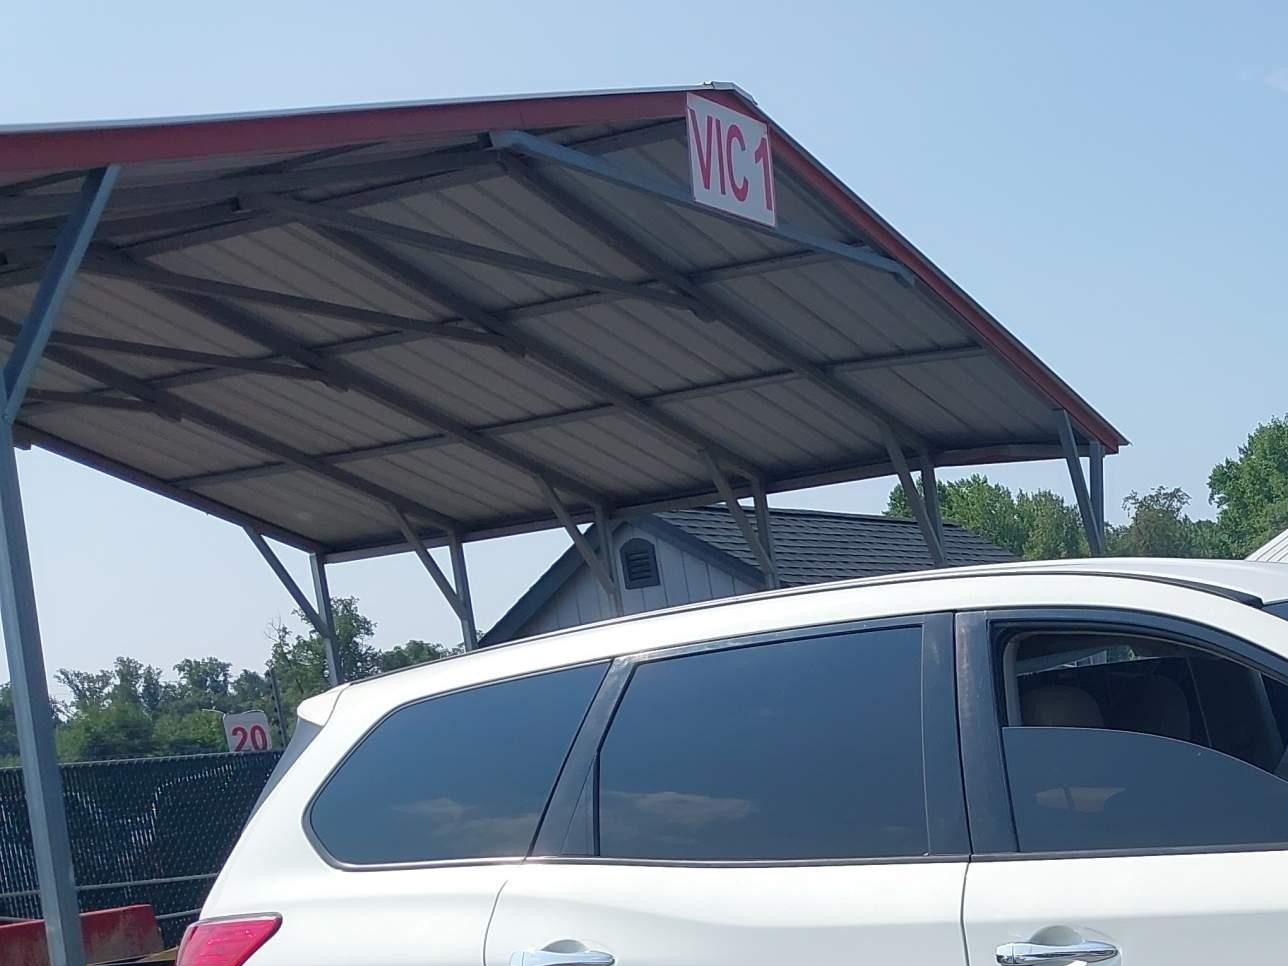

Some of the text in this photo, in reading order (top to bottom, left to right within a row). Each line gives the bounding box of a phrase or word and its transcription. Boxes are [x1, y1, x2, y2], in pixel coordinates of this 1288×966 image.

[688, 108, 773, 211] VIC 1
[231, 725, 268, 753] 20
